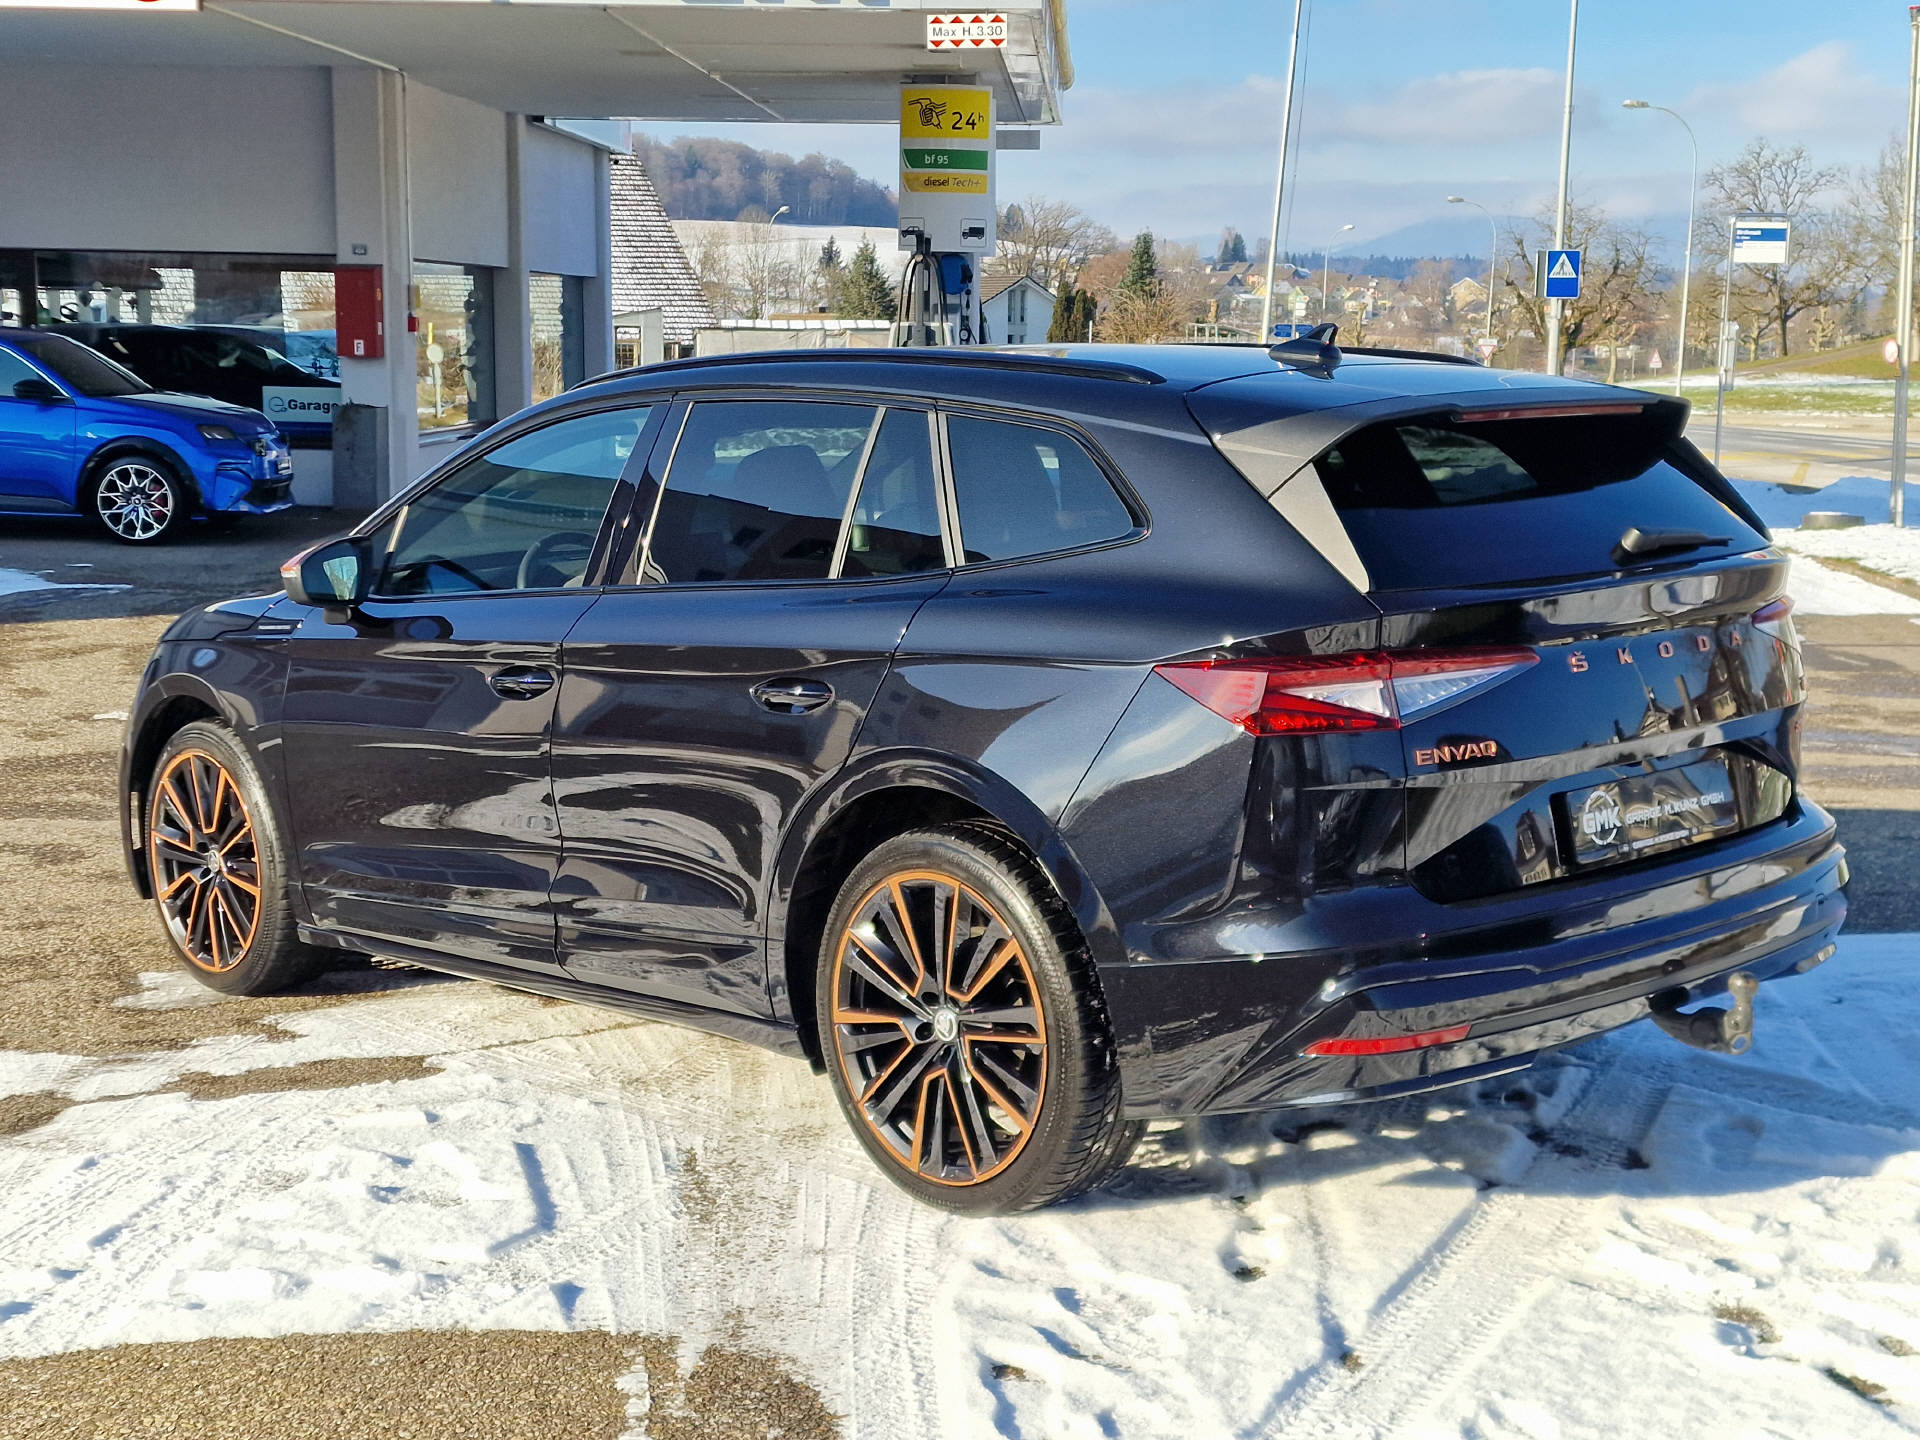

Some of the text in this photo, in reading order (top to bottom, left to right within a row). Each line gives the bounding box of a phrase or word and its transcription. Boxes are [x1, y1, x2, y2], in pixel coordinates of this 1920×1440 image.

[932, 26, 957, 37] Max
[976, 25, 1003, 37] 3.30
[924, 154, 950, 165] bf 95
[923, 176, 982, 188] diesel Tech+
[1568, 631, 1743, 673] ŠKODA
[1415, 740, 1498, 766] ENYAQ
[1583, 806, 1622, 835] GMK
[1625, 807, 1663, 825] GARAGE
